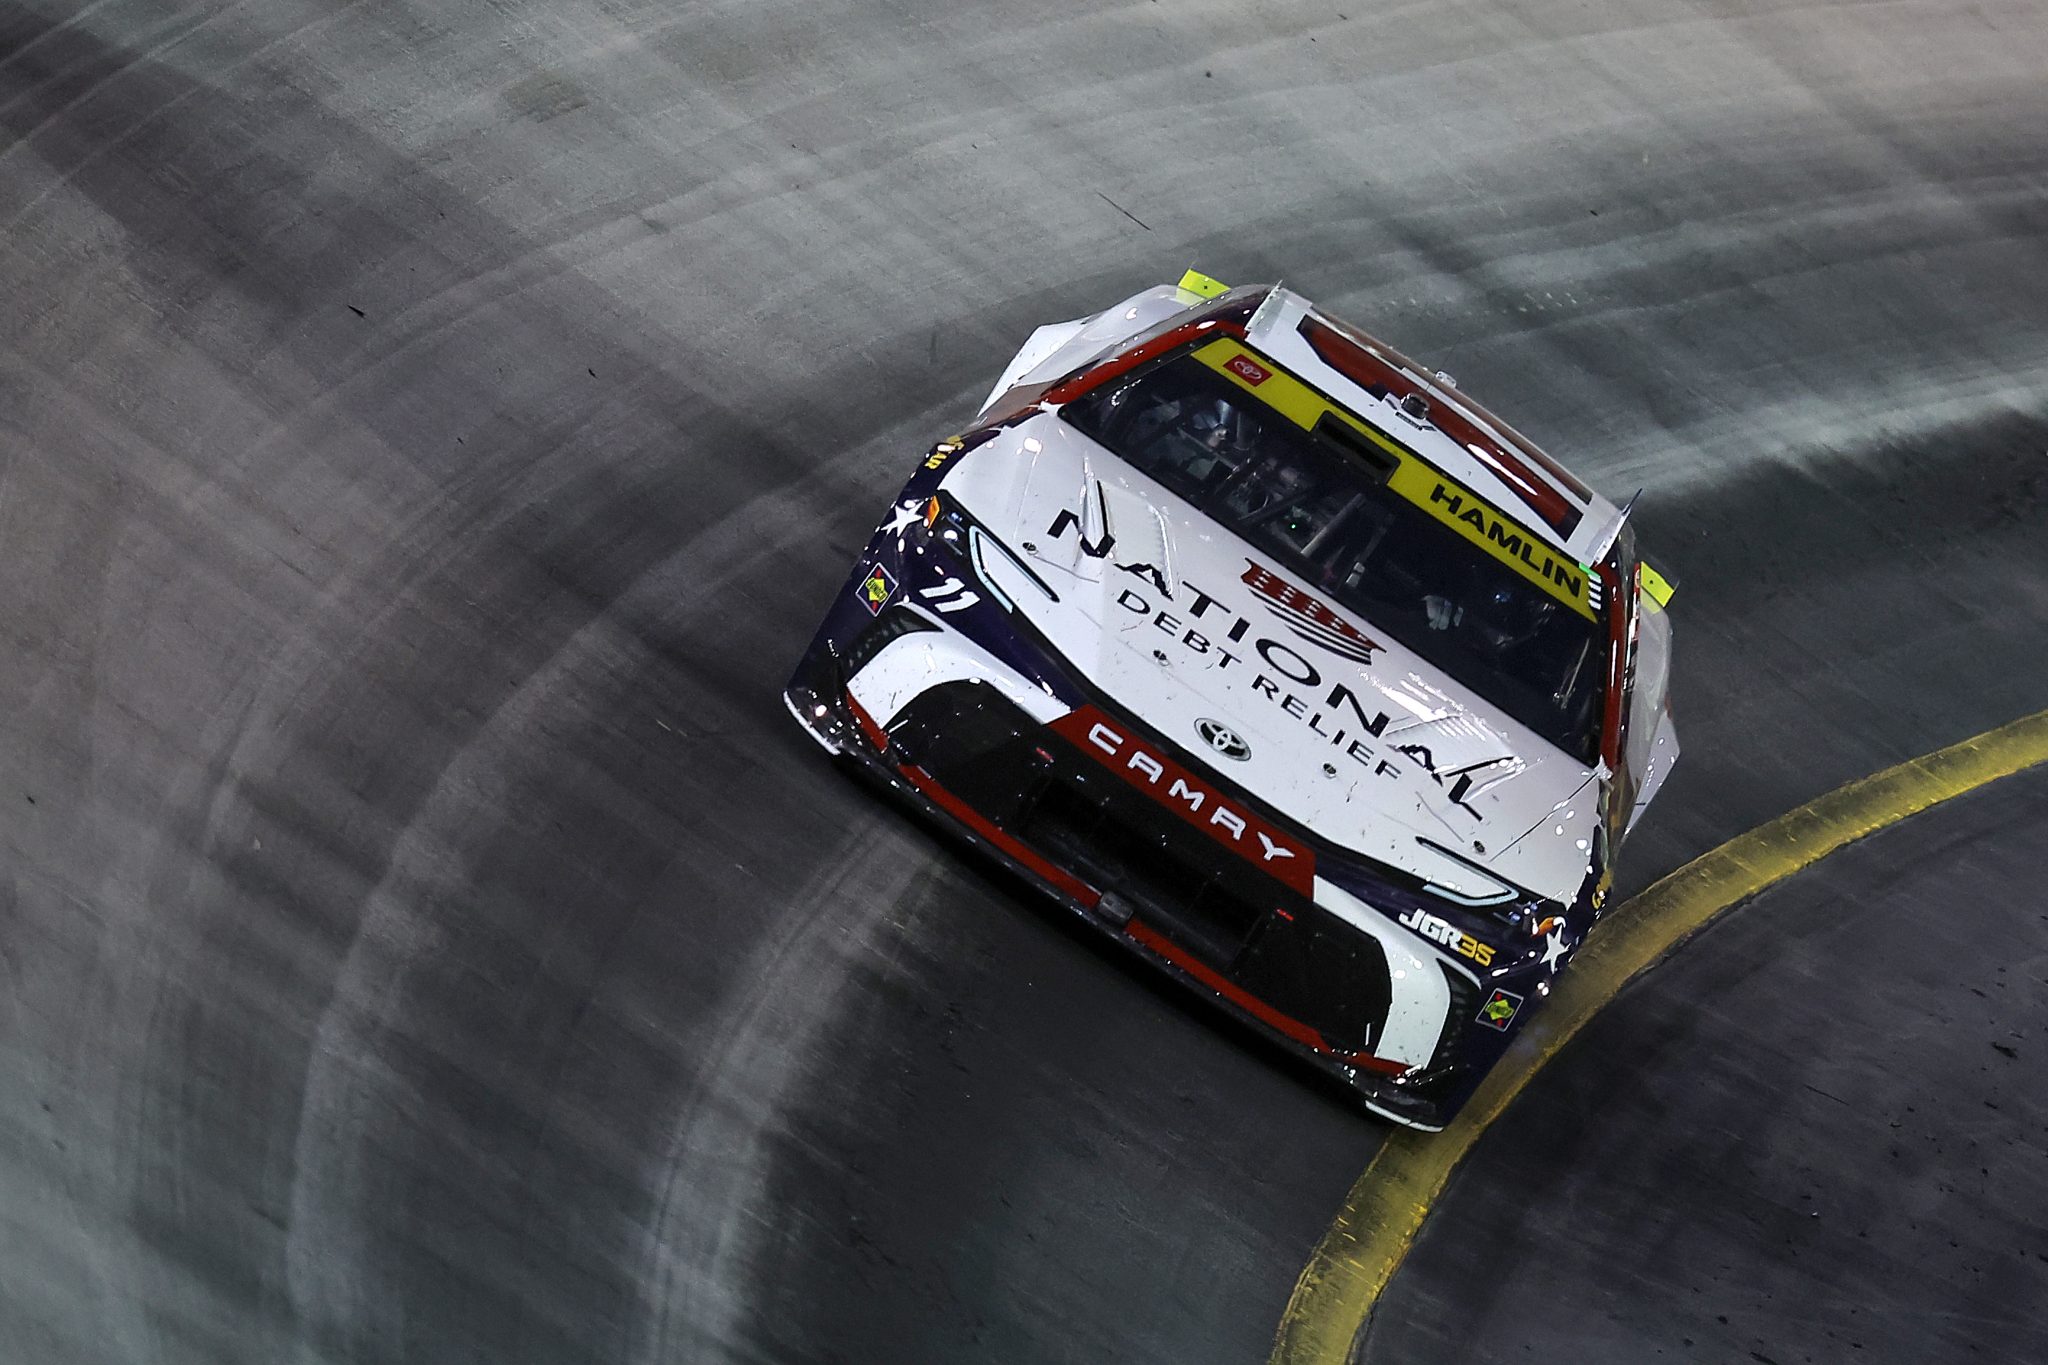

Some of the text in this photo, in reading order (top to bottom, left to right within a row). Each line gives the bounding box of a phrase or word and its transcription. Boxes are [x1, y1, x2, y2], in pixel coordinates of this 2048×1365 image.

[919, 577, 981, 613] 11
[1429, 483, 1582, 598] HAMLIN
[1047, 482, 1484, 822] NATIONAL
[1117, 588, 1402, 780] DEBT RELIEF
[1088, 722, 1296, 861] CAMRY
[1398, 907, 1497, 967] JGR35
